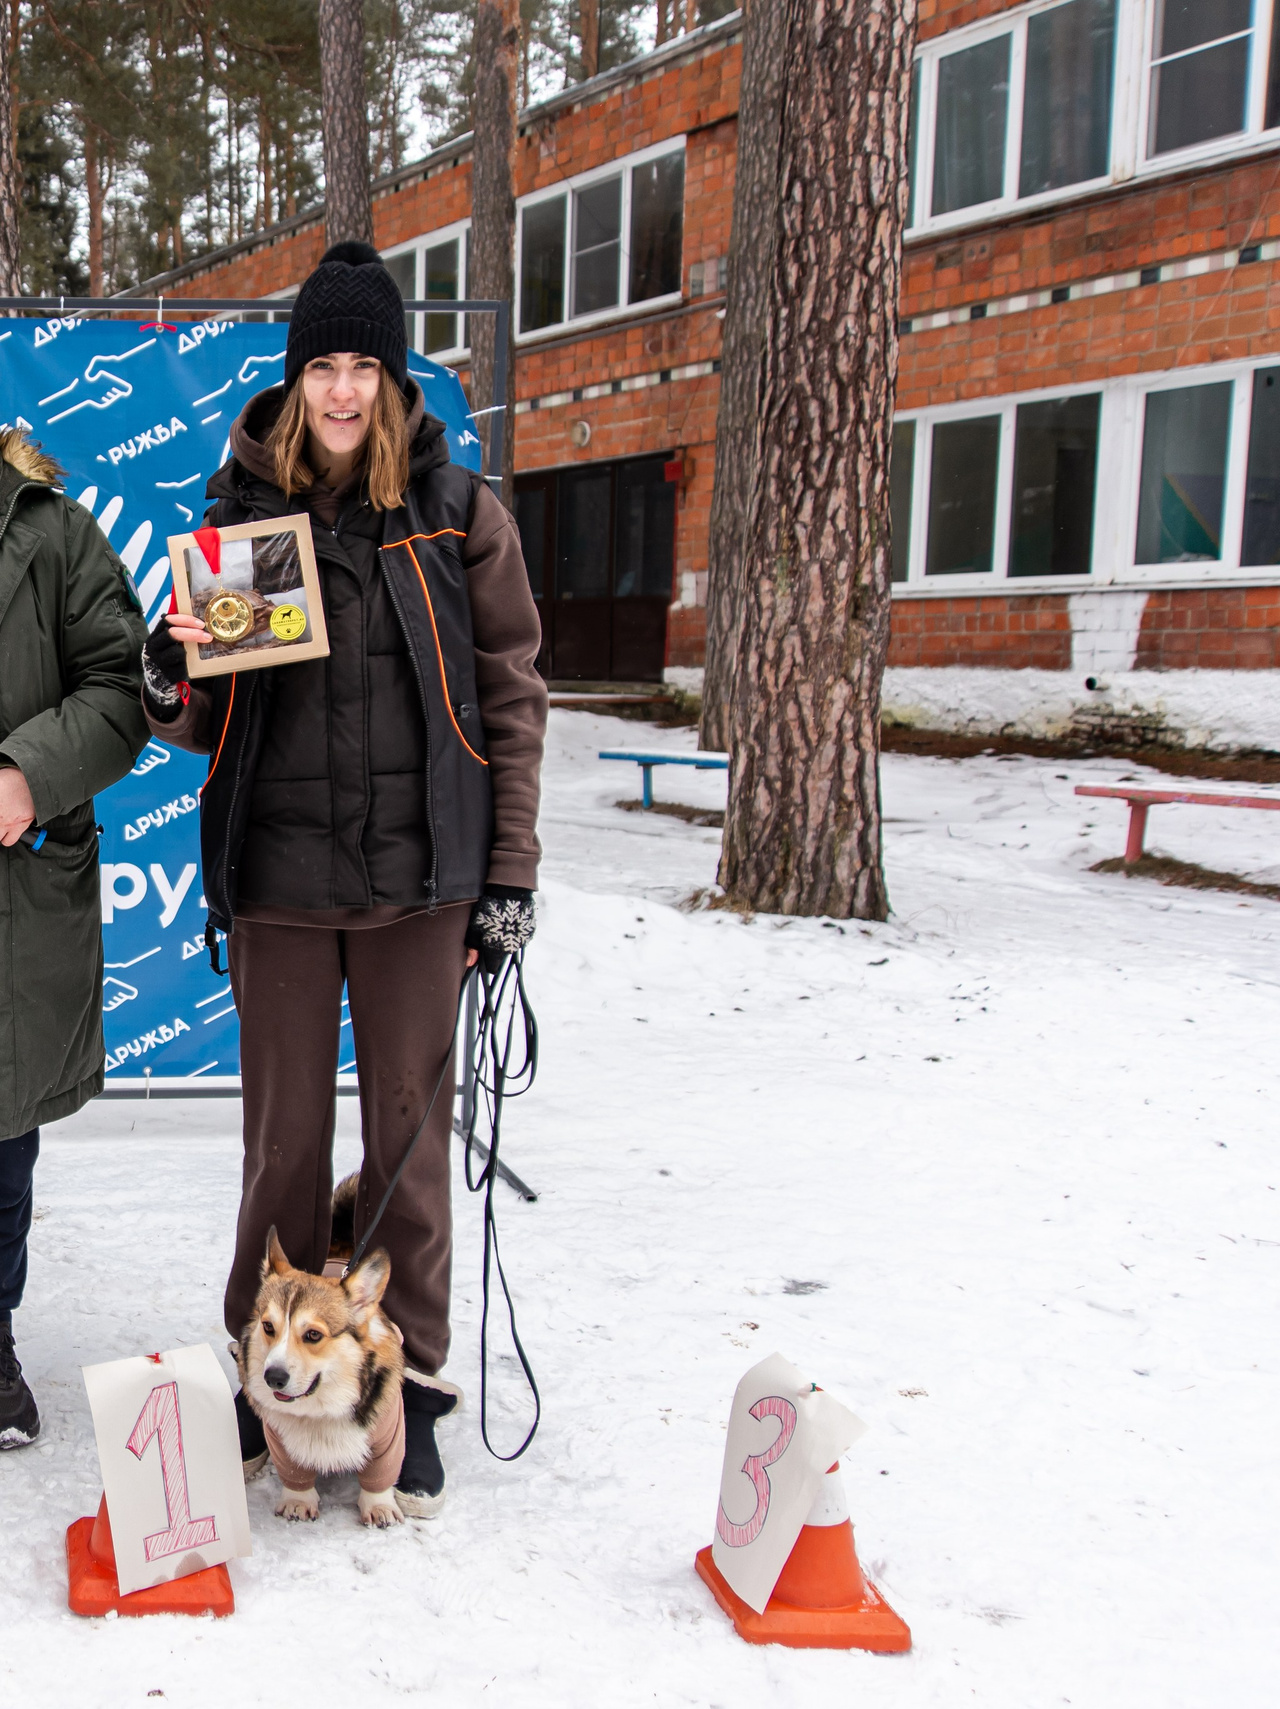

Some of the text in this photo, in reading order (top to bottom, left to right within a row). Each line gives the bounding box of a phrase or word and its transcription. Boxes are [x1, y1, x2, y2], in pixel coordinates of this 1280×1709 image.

[34, 318, 90, 348] ДРУ
[179, 321, 234, 354] ДРУ
[97, 416, 187, 464] РУЖБА
[104, 1017, 191, 1073] ДРУЖБА
[125, 1381, 220, 1563] 1
[717, 1396, 797, 1548] 3
